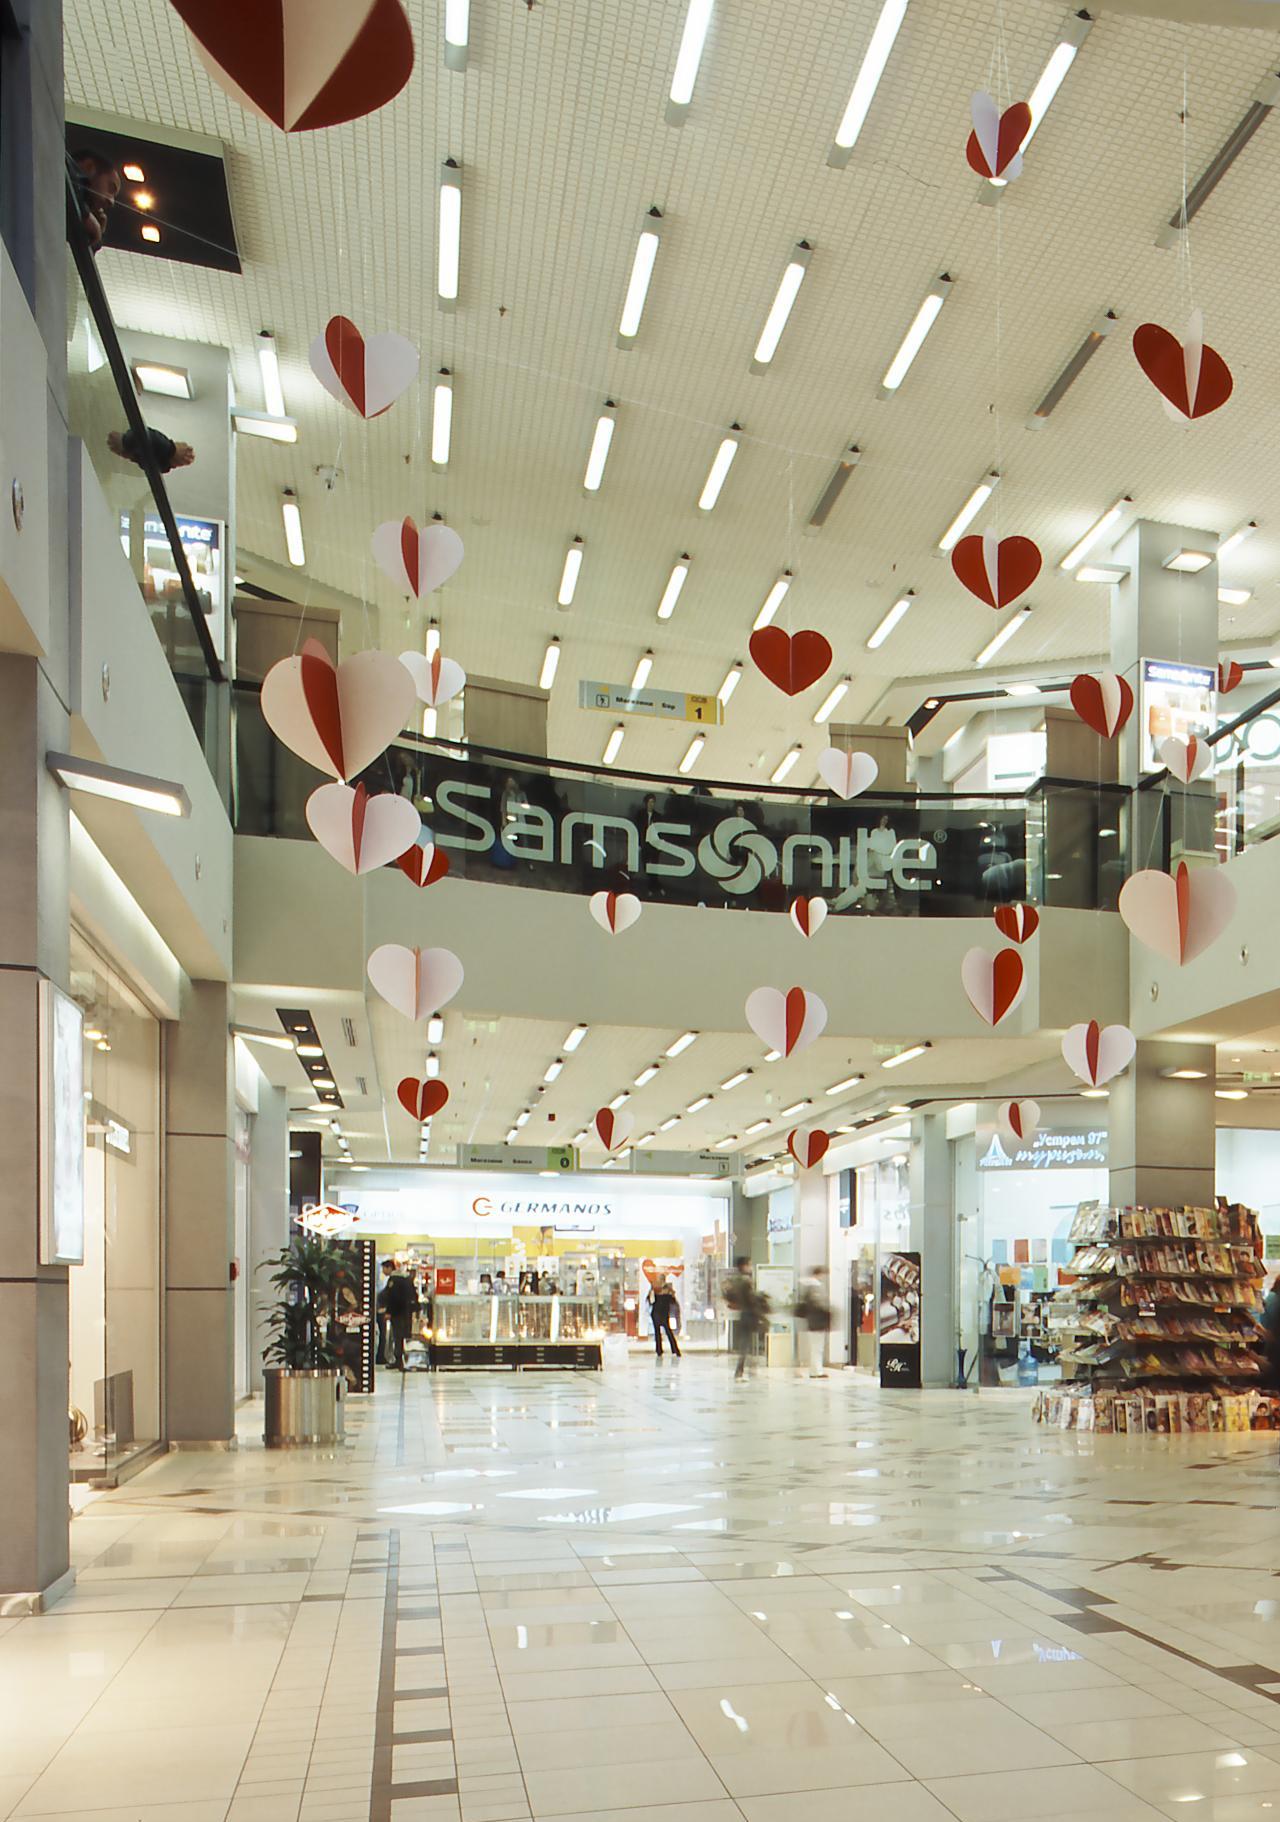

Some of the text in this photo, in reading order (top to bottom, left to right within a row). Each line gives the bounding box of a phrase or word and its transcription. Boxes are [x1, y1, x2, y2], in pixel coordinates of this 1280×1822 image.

[695, 707, 702, 719] 1
[435, 780, 938, 894] Samsonite
[501, 1201, 612, 1215] GERMANOS
